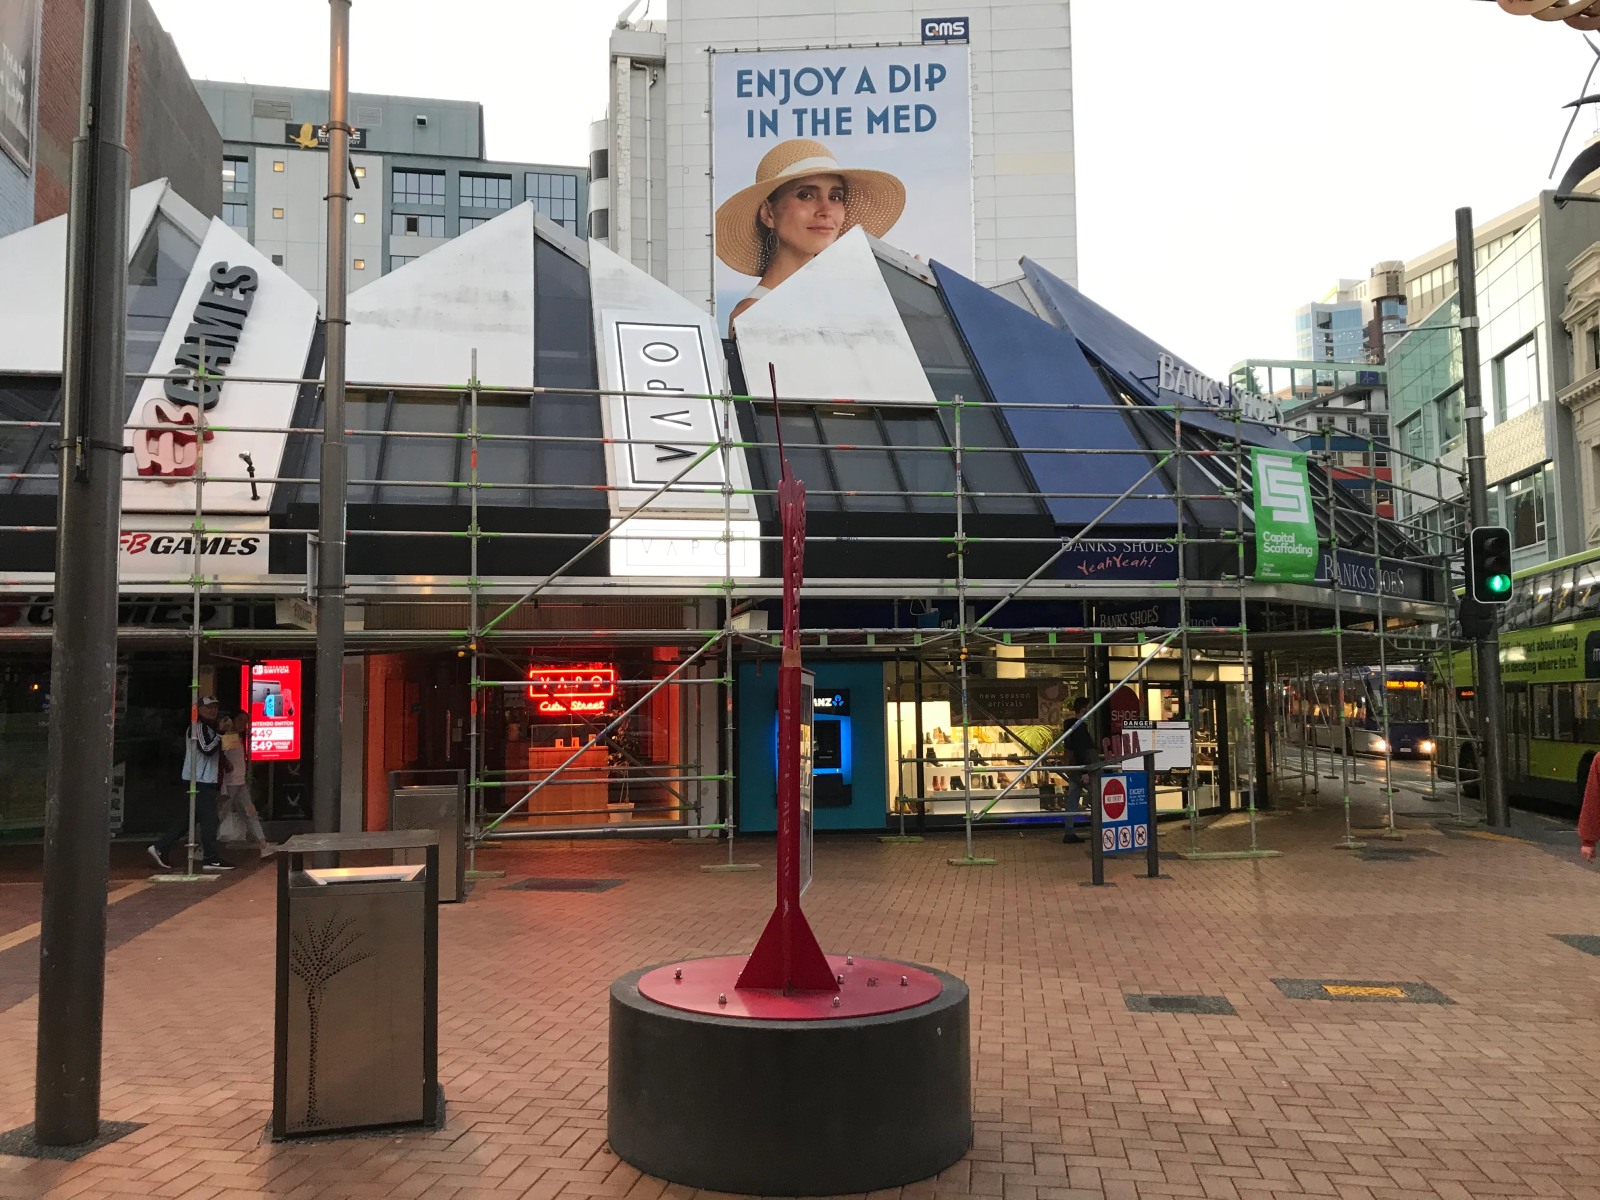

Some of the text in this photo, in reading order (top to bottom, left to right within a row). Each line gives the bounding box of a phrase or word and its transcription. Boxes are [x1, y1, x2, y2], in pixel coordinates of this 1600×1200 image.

[737, 63, 947, 105] ENJOY A DIP
[747, 104, 938, 138] IN THE MED
[164, 261, 259, 410] GAMES
[1158, 352, 1226, 408] BANKS
[642, 341, 698, 462] VAPO
[150, 536, 260, 555] GAMES
[1122, 540, 1175, 553] SHOES
[1262, 531, 1296, 544] Capital
[1263, 542, 1313, 557] Scaffolding
[1324, 554, 1367, 589] BANKS
[1100, 605, 1159, 628] BANKS SHOES
[1190, 617, 1218, 627] HOES
[1537, 637, 1555, 651] about
[1557, 633, 1578, 651] riding
[570, 700, 605, 711] Street
[813, 697, 833, 707] ANZ
[1111, 709, 1138, 721] SHOE
